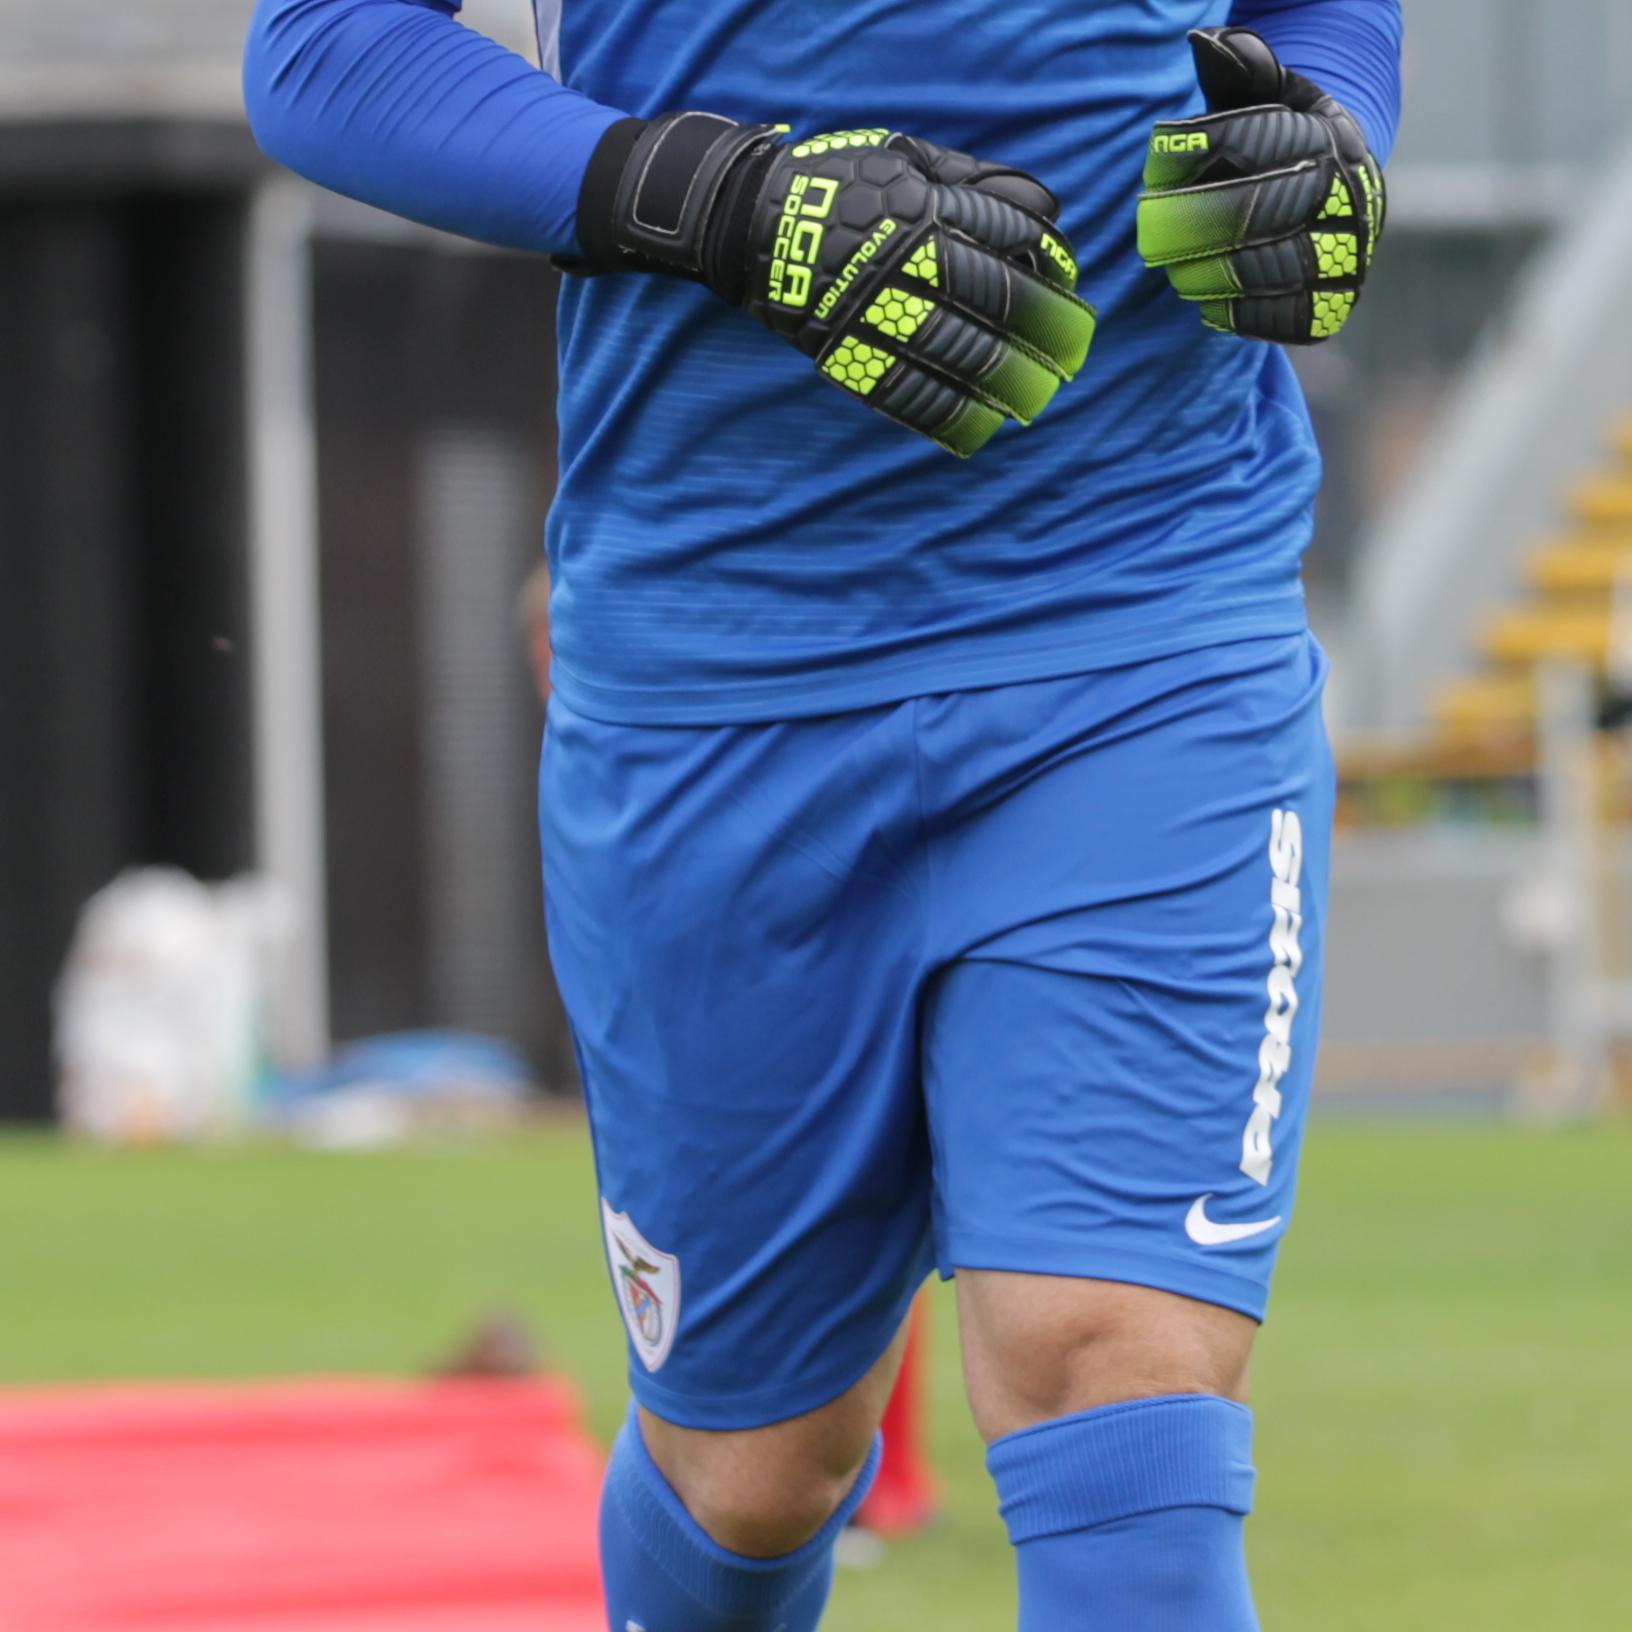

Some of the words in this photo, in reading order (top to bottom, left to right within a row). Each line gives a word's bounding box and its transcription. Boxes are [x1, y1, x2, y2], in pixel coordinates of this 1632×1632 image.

[768, 174, 810, 302] SOCCER
[781, 176, 840, 308] NGA
[814, 218, 897, 321] EVOLUTION
